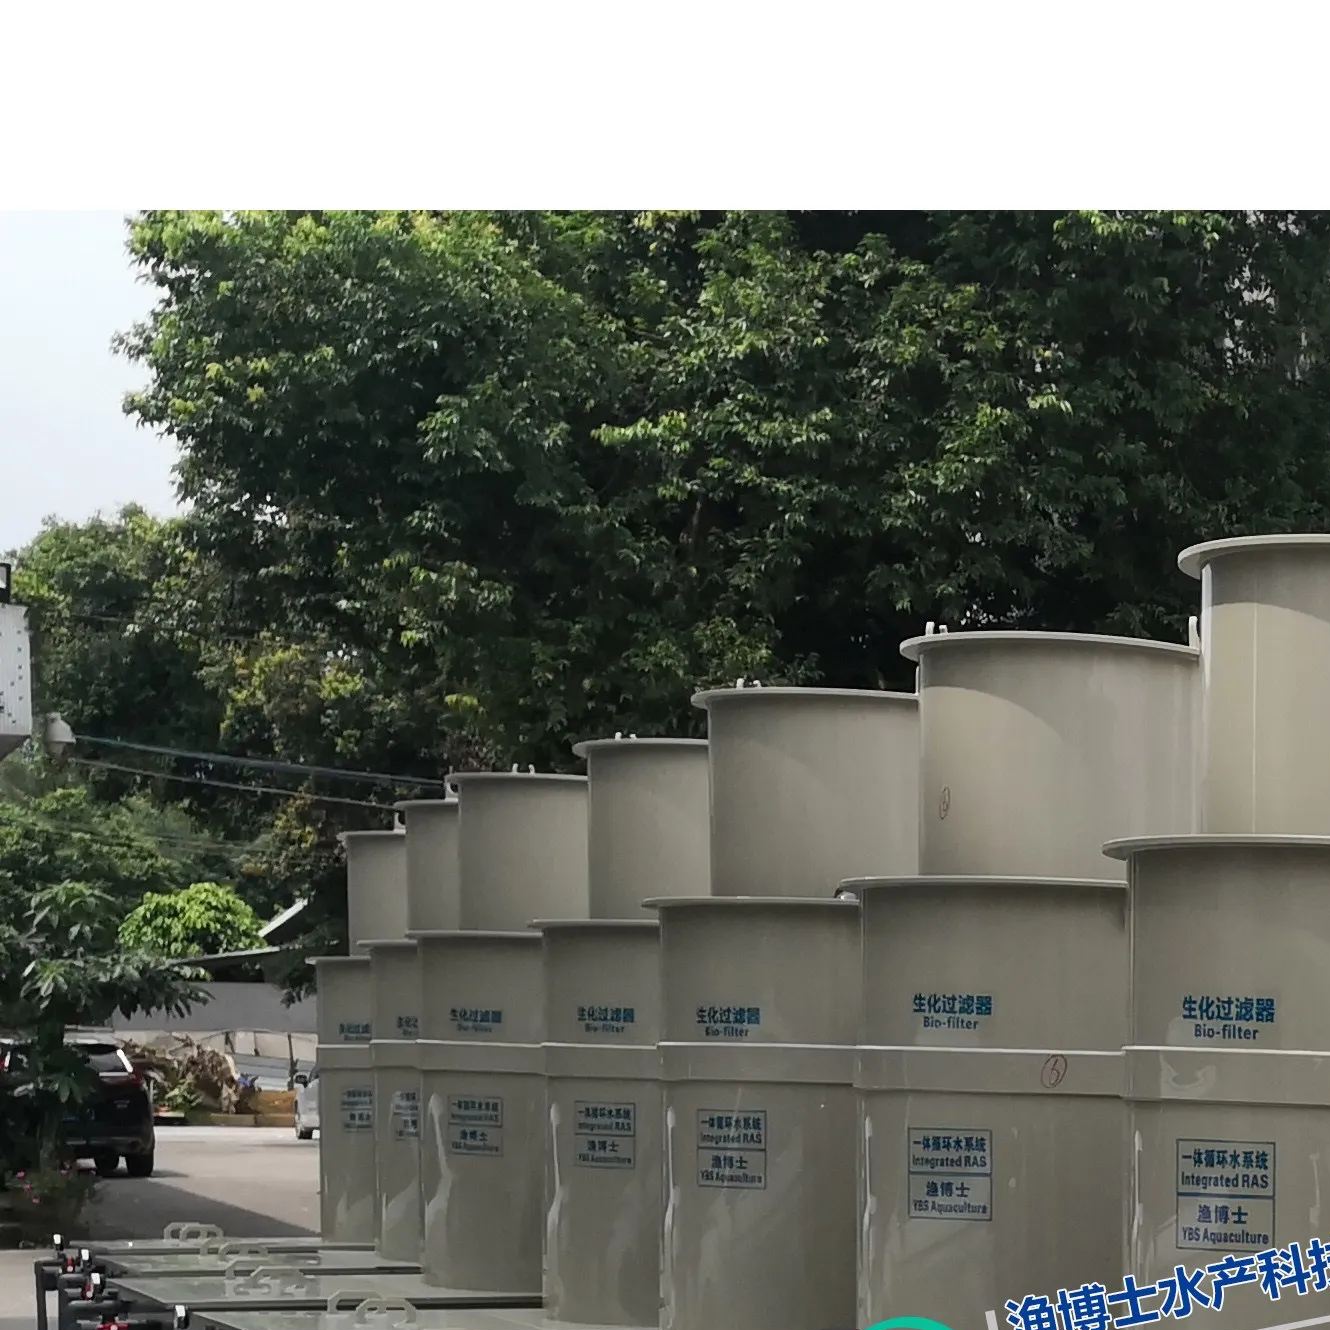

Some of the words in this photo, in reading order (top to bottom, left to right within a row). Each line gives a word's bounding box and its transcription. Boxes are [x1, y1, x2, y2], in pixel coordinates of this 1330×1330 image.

[912, 993, 993, 1016] 生化过滤器
[1182, 996, 1275, 1023] 生化过滤器
[923, 1016, 979, 1031] Bio-filter
[1194, 1024, 1259, 1040] Bio-filter
[913, 1136, 986, 1153] 一体循环水系统
[912, 1154, 962, 1169] Integrated
[964, 1155, 987, 1169] RAS
[1182, 1148, 1268, 1170] 一体循环水系统
[1181, 1172, 1239, 1189] Integrated
[1241, 1174, 1269, 1189] RAS
[926, 1181, 970, 1198] 渔博士
[1197, 1204, 1248, 1225] 渔博士
[1182, 1227, 1200, 1243] YBS
[1203, 1228, 1269, 1246] Aquaculture
